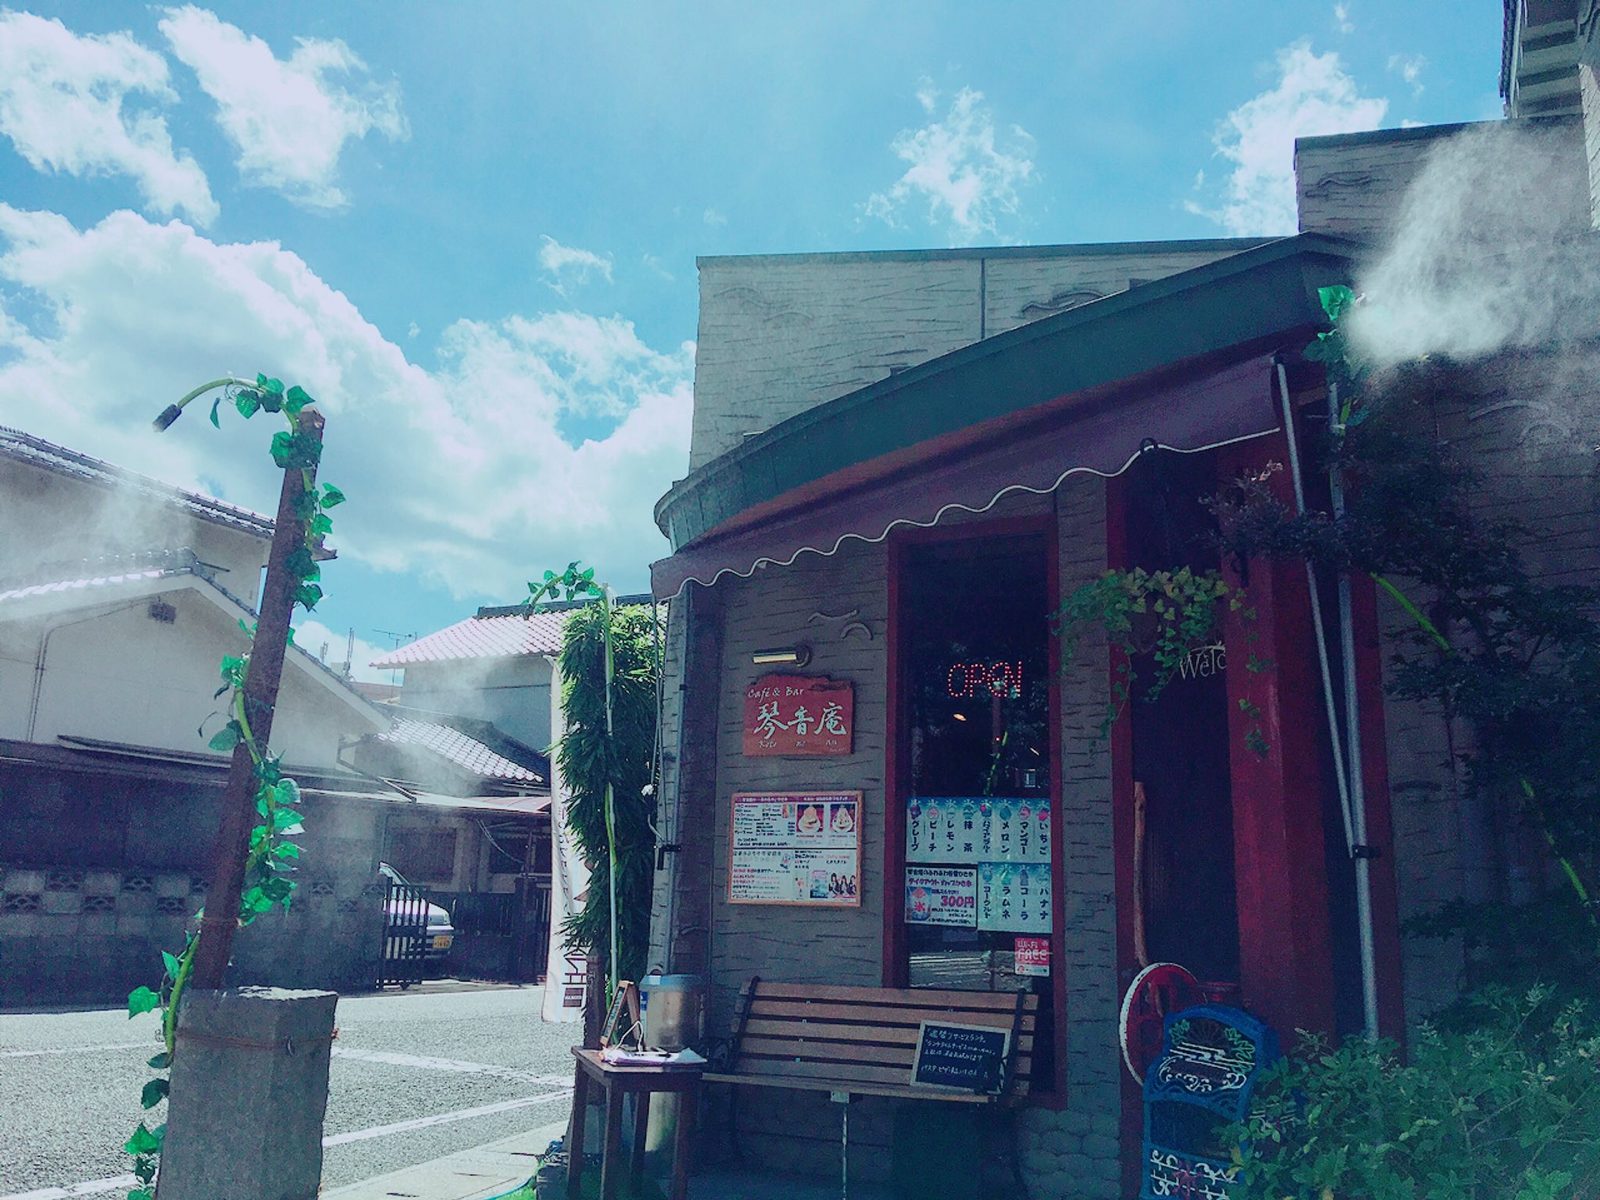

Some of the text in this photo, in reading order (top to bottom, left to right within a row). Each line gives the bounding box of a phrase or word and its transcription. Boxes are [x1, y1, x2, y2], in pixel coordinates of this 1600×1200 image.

[786, 686, 804, 696] Bar
[948, 660, 1021, 697] OPEN
[753, 700, 847, 740] 琴音庵
[946, 820, 955, 852] レモン
[963, 820, 973, 853] 抹茶
[1001, 821, 1010, 854] メロン
[1019, 821, 1029, 855] マンゴー
[1039, 822, 1049, 856] いちご
[941, 895, 974, 909] 300円
[1002, 886, 1011, 919] ラムネ
[1020, 887, 1029, 920] コーラ
[1017, 949, 1047, 961] FREE
